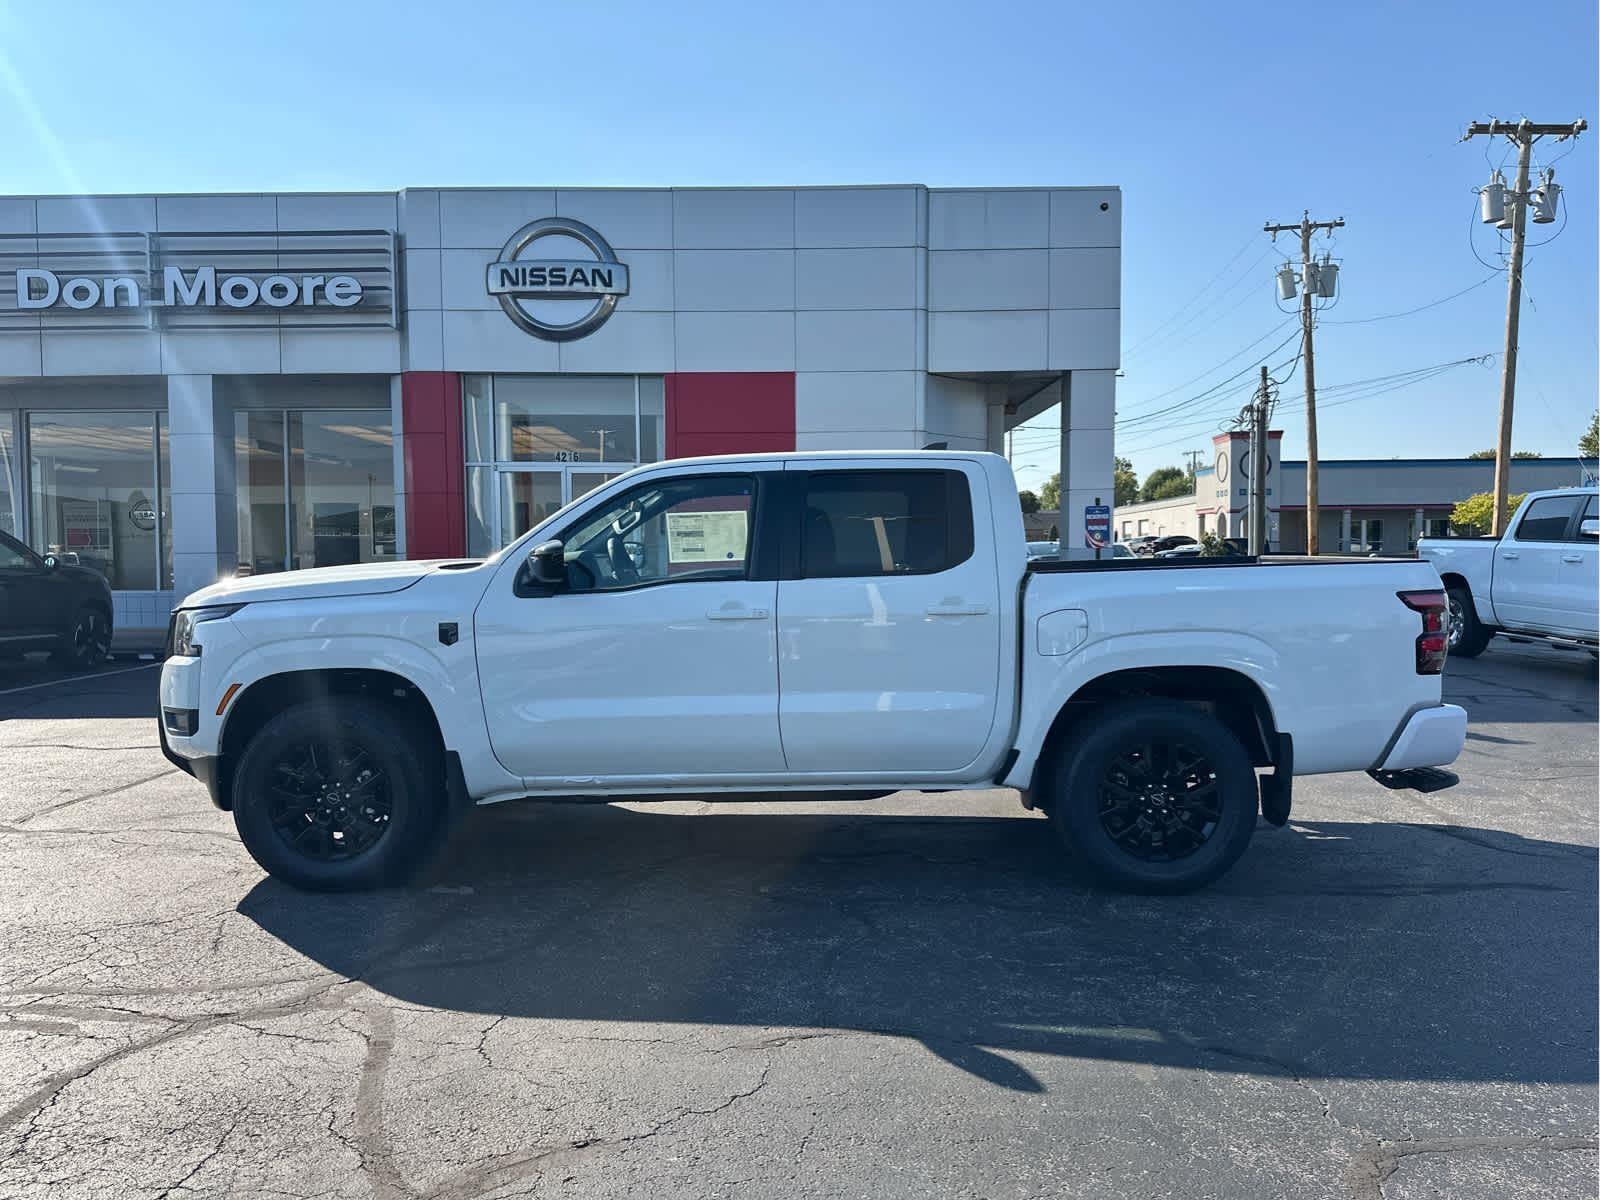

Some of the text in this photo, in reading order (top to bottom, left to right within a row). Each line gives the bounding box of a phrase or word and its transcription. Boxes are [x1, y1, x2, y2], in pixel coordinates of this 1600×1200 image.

[16, 265, 363, 310] Don Moore
[500, 267, 613, 288] NISSAN
